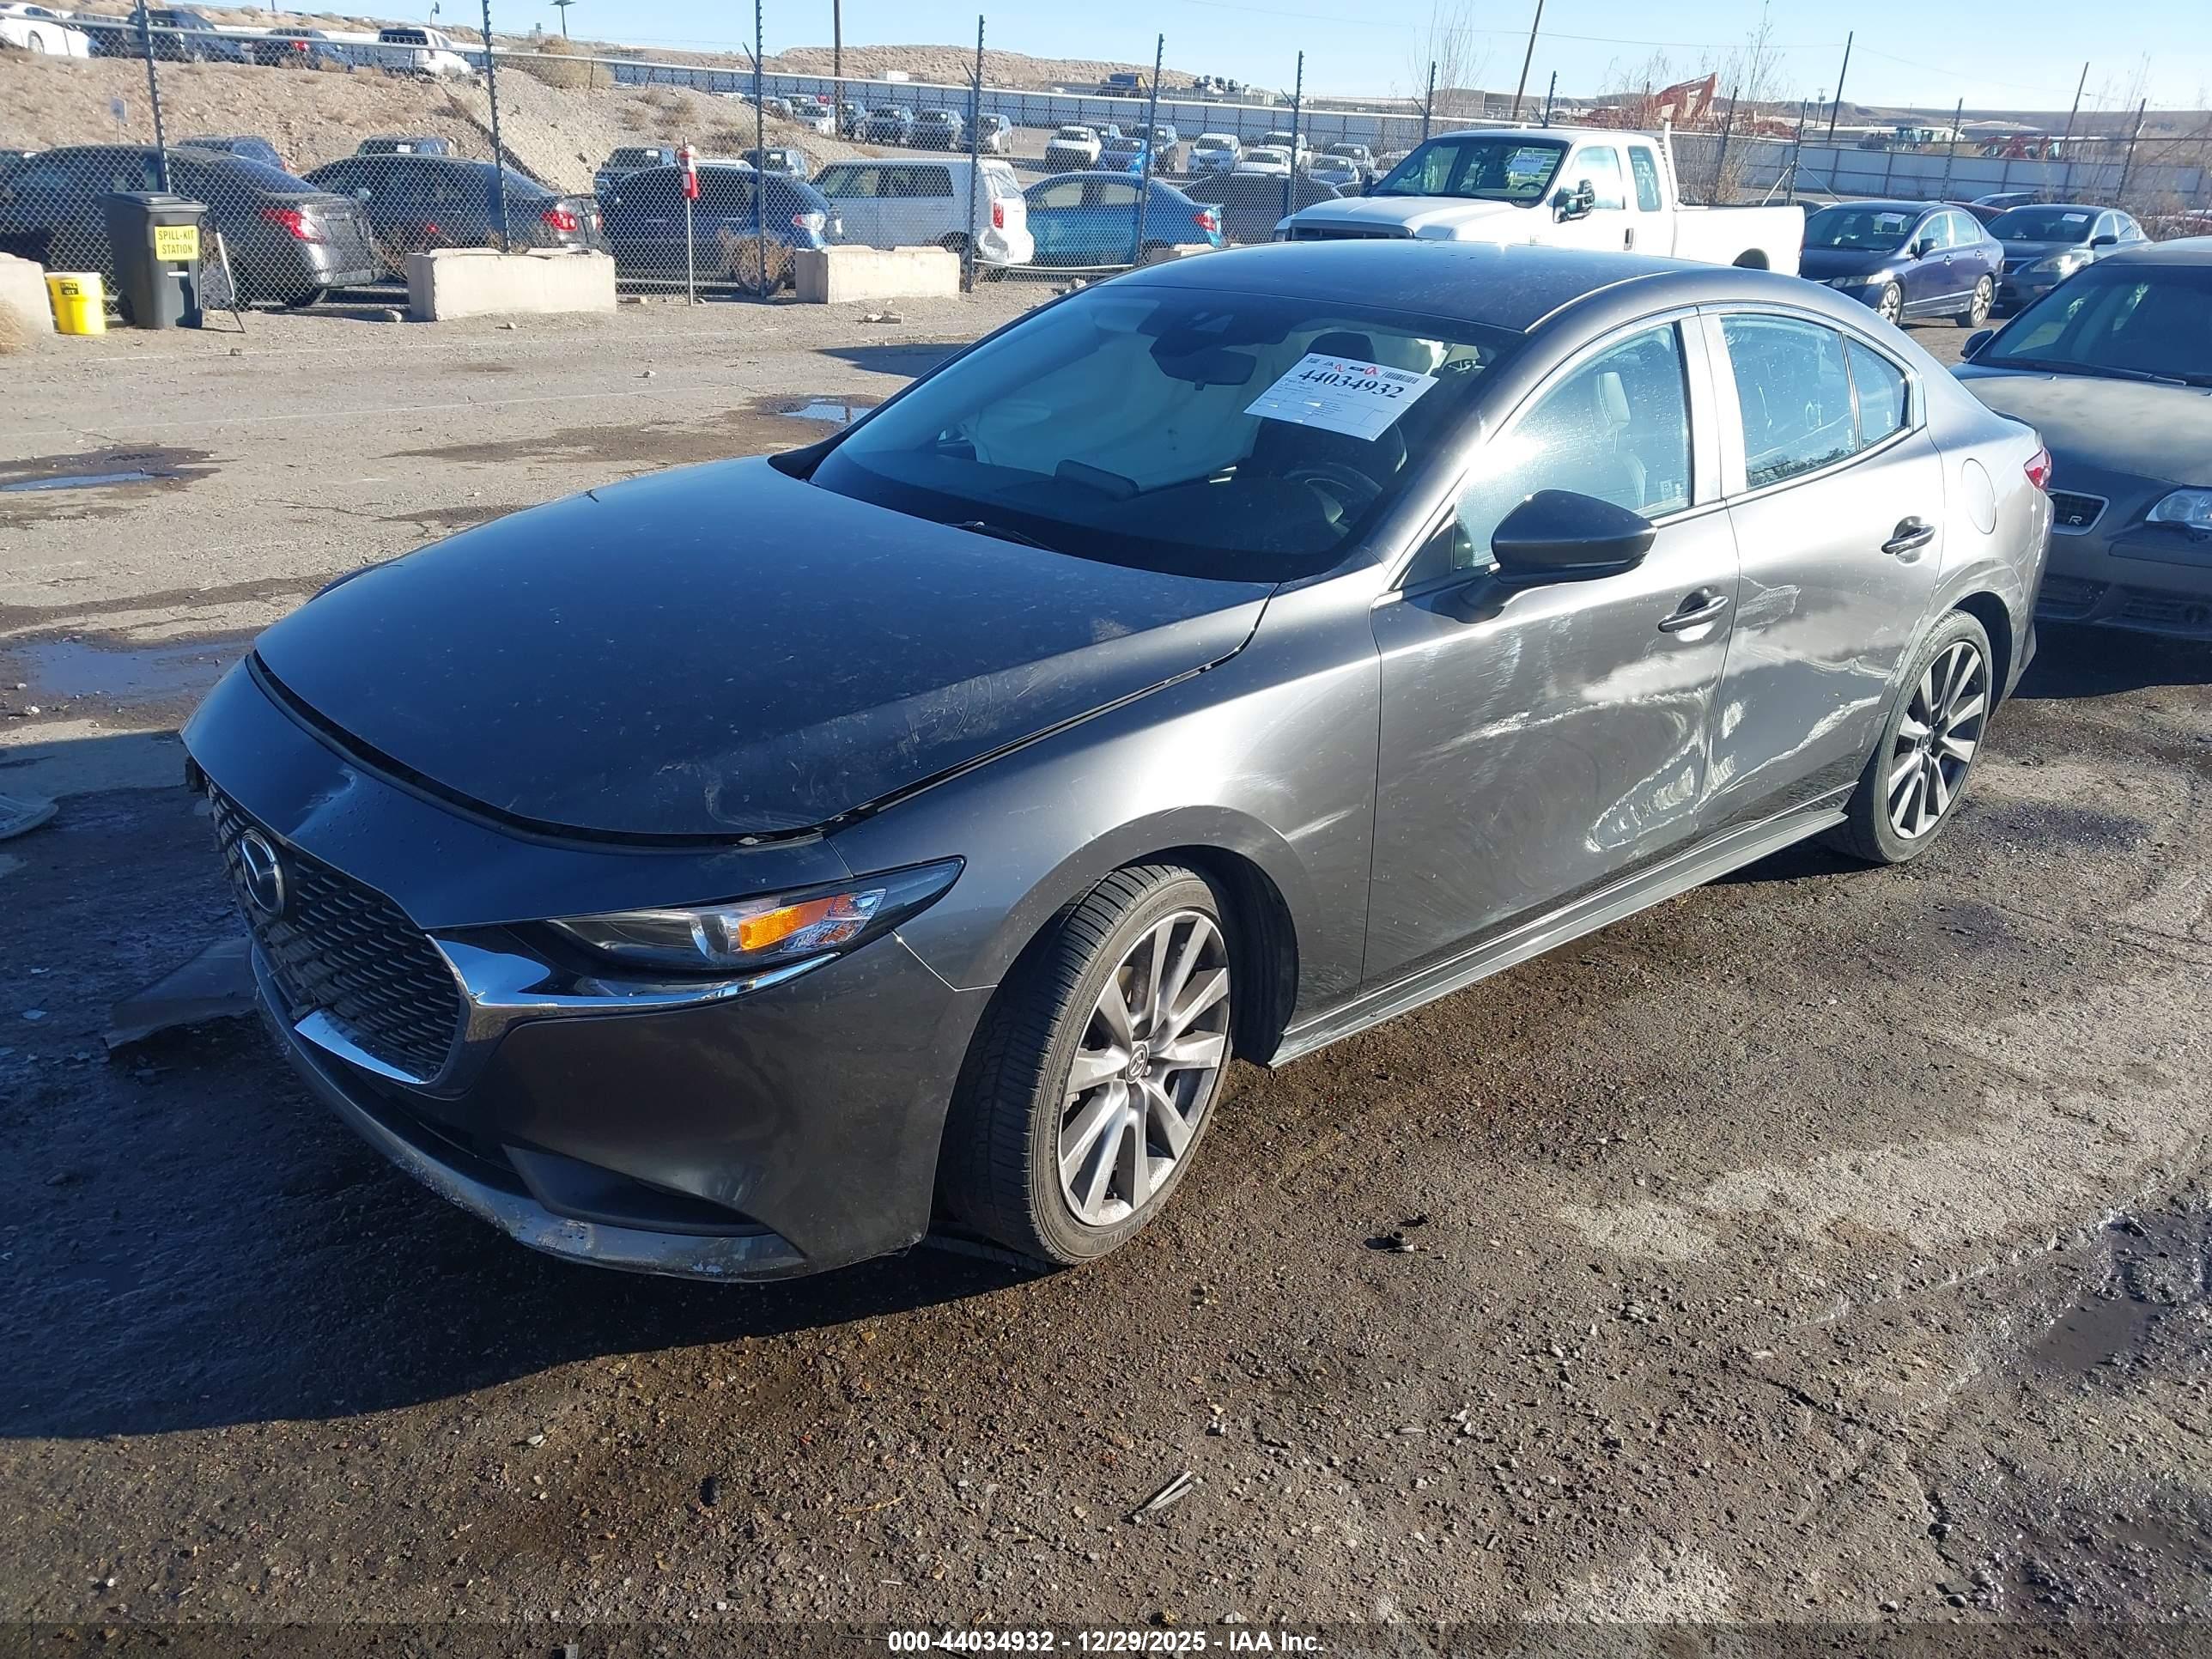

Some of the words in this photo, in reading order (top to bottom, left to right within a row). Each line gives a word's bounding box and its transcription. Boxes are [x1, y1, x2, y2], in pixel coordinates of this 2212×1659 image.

[158, 230, 194, 240] SPILL-KIT
[161, 244, 193, 254] STATION
[1298, 369, 1405, 398] 44034932
[2069, 515, 2082, 525] R
